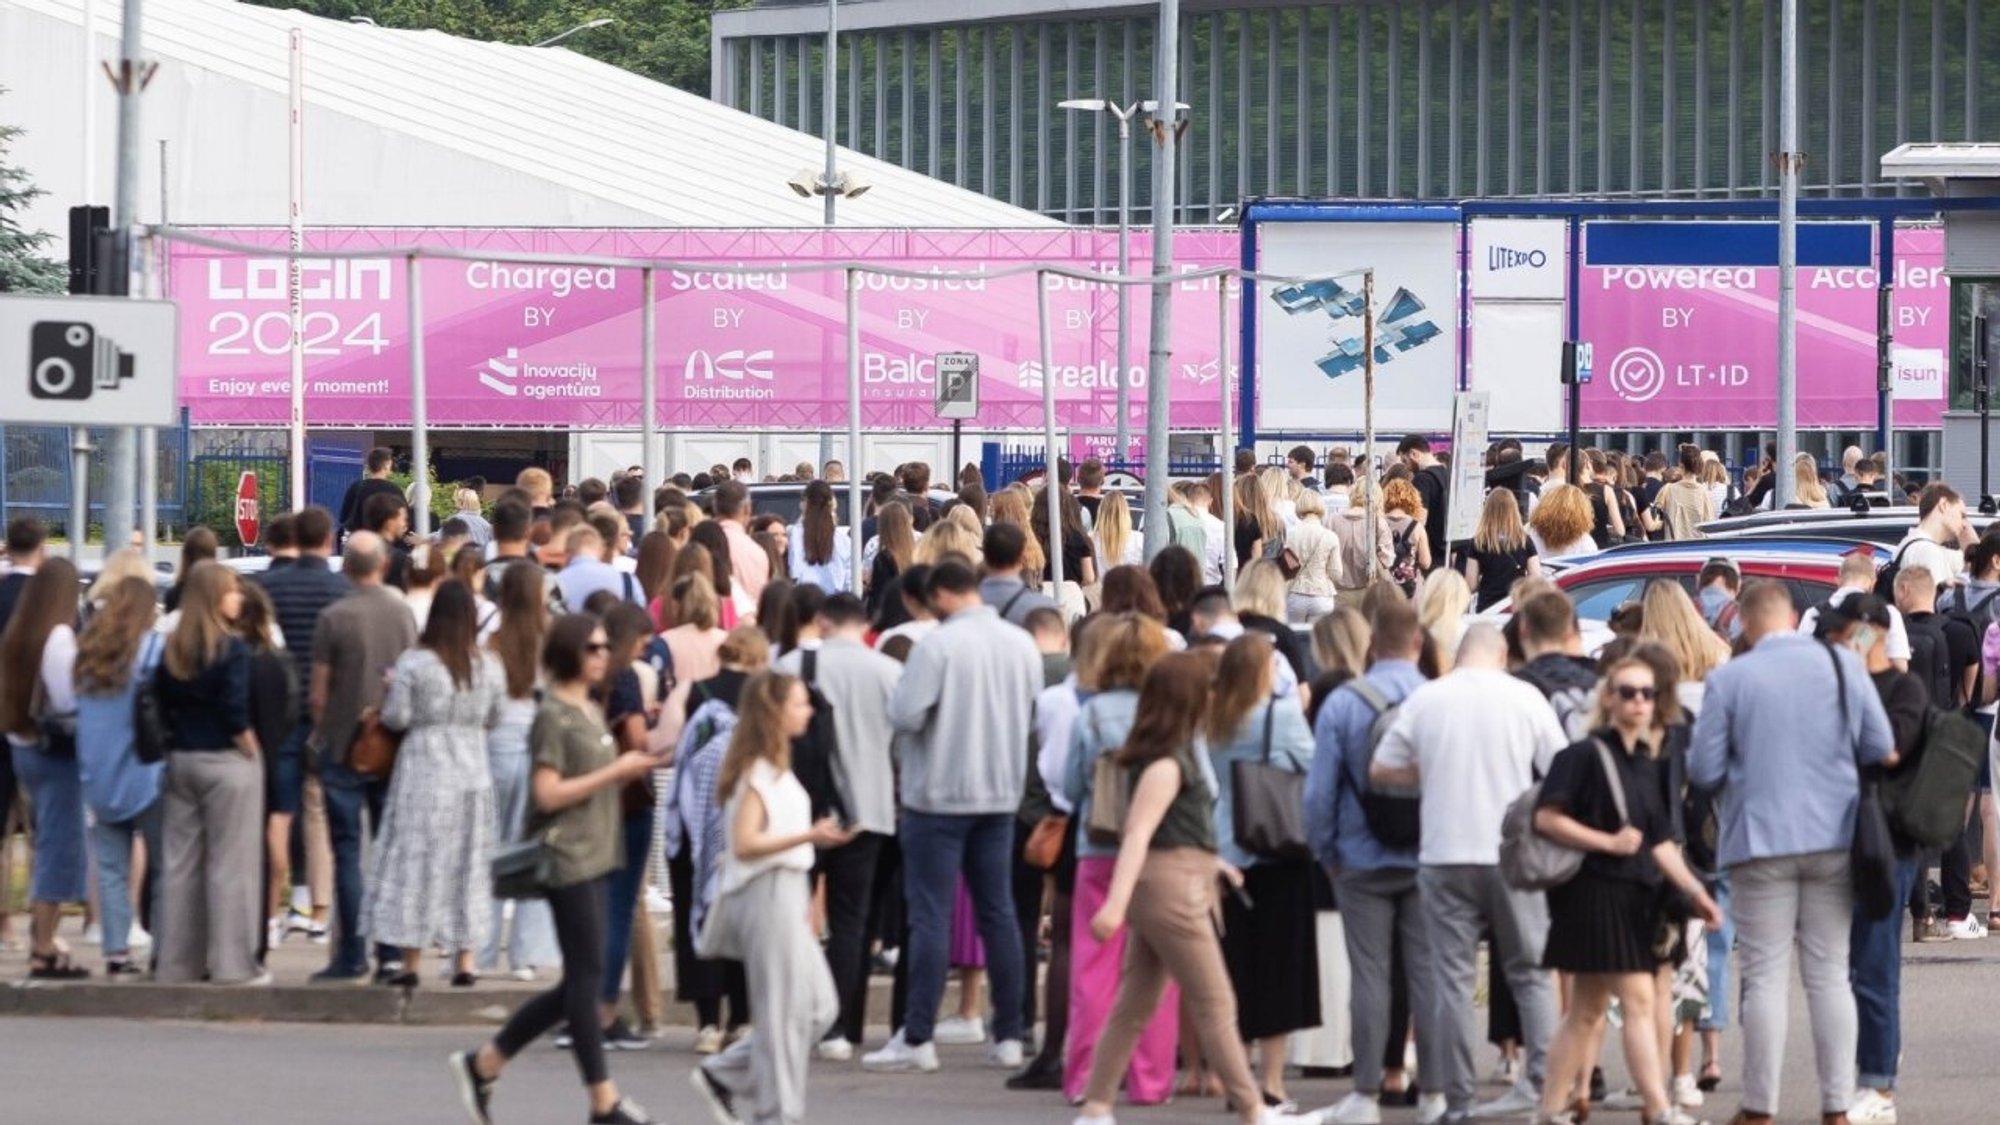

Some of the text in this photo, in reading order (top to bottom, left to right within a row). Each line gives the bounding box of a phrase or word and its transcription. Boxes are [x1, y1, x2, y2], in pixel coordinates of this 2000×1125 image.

[1489, 245, 1546, 271] LITEXPO
[209, 259, 391, 300] LOGIN
[466, 261, 616, 297] Charged
[671, 261, 788, 291] Scaled
[1602, 267, 1756, 289] Powered
[1811, 259, 1951, 289] Accler
[524, 306, 556, 327] BY
[713, 308, 744, 328] BY
[898, 309, 929, 328] BY
[1066, 309, 1097, 329] BY
[1662, 307, 1695, 328] BY
[1899, 306, 1931, 327] BY
[208, 311, 390, 355] 2024
[944, 357, 970, 366] ZONA
[523, 363, 597, 381] Inovacijų
[1898, 366, 1938, 381] isun
[209, 379, 389, 395] Enjoy eve moment!
[523, 382, 601, 399] agentūra
[684, 386, 774, 399] Distribution
[863, 387, 935, 397] insura
